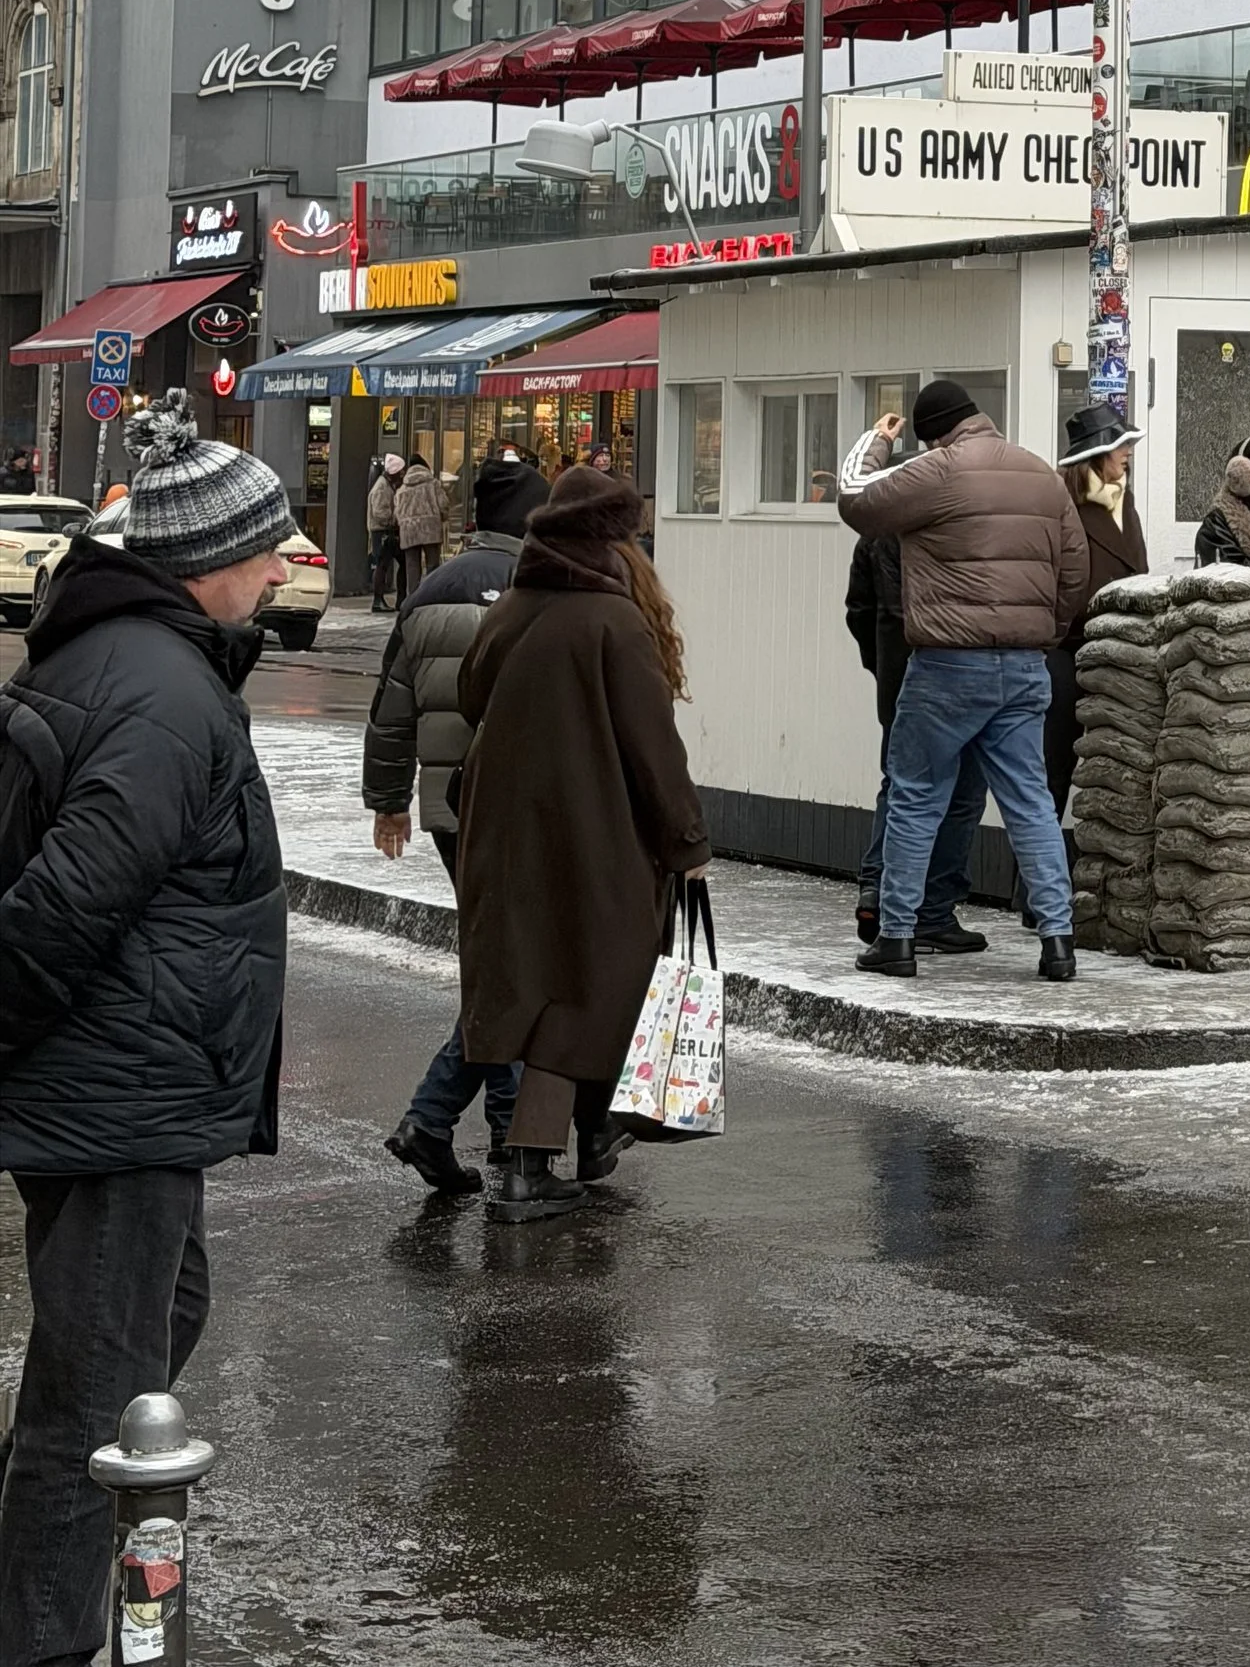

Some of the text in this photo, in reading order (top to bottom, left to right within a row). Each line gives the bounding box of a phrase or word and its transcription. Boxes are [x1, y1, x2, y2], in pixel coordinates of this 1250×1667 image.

[201, 41, 338, 93] McCafé
[972, 62, 1092, 94] ALLIED CHECKPOIN
[664, 111, 772, 214] SNACKS
[920, 129, 1009, 182] ARMY
[368, 258, 457, 310] SOUVENIRS
[96, 366, 126, 381] TAXI
[523, 374, 582, 391] BACK-FACTORY
